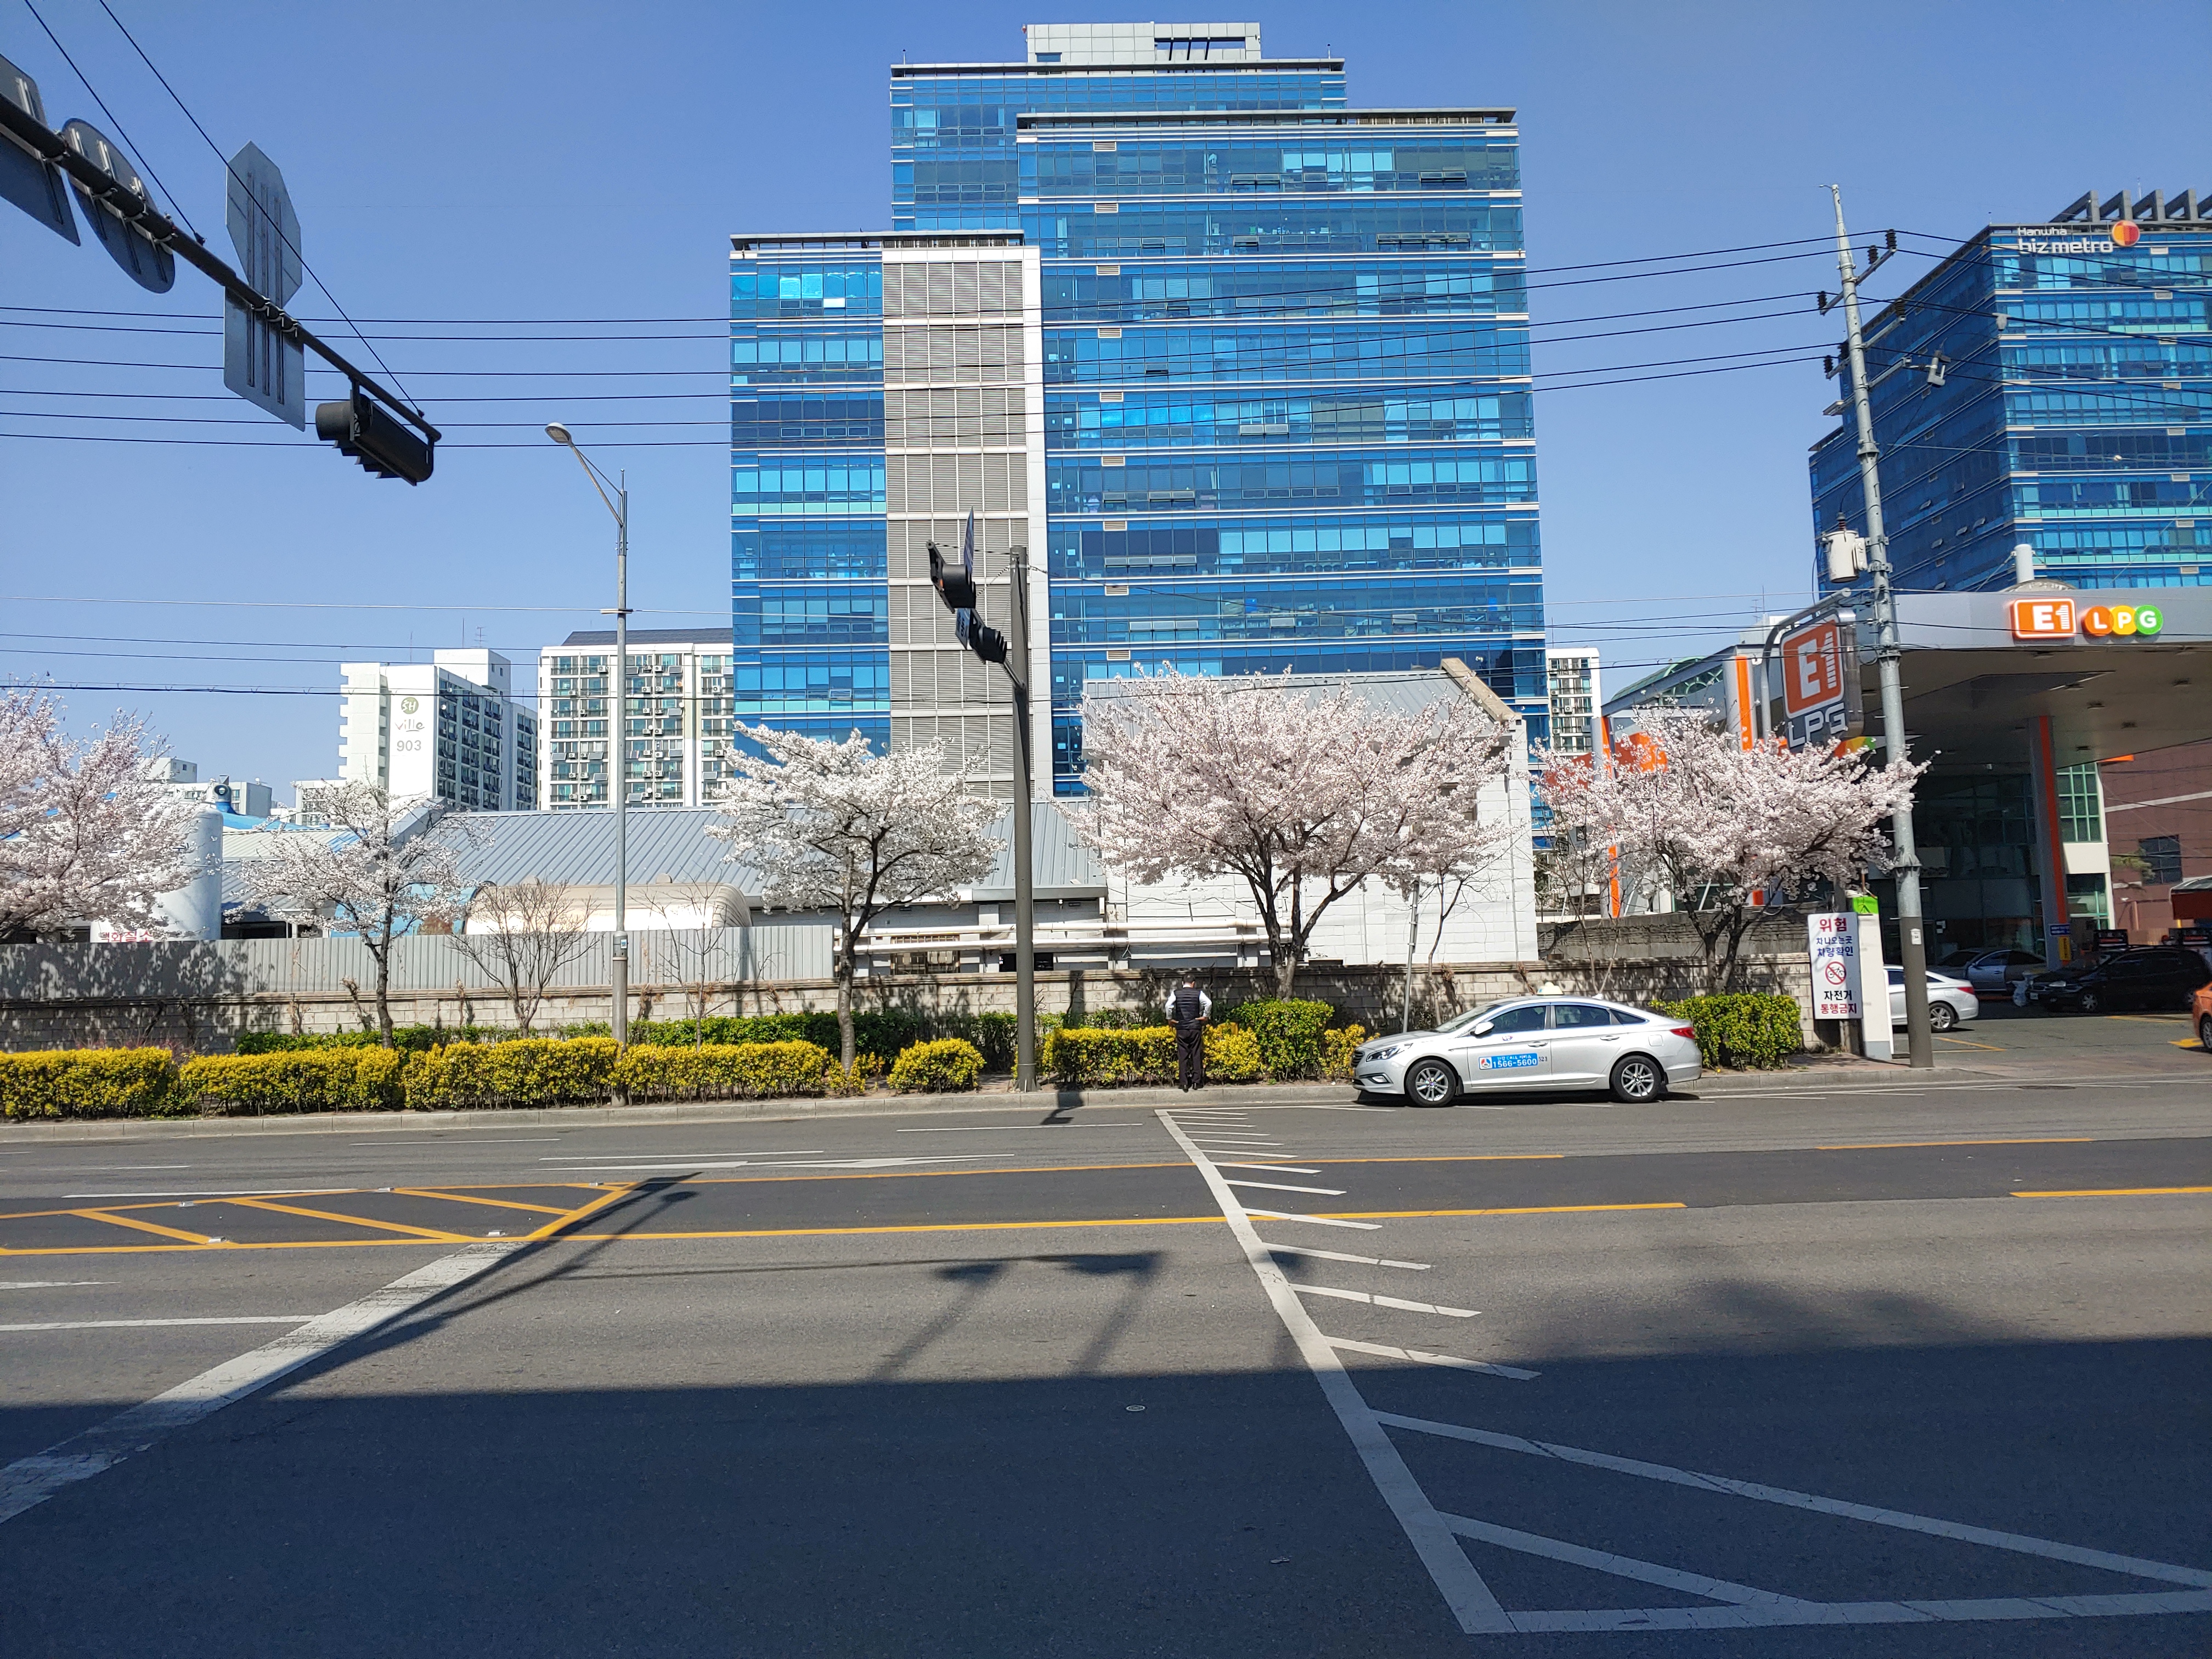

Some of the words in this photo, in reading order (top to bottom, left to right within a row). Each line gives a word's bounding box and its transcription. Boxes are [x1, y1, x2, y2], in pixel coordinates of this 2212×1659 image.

[2018, 227, 2067, 236] Hanwha
[2052, 237, 2113, 253] metro
[2033, 605, 2070, 630] E1
[2094, 611, 2156, 629] LPG
[1798, 631, 1837, 699] E1
[394, 719, 425, 730] ville
[1788, 702, 1846, 748] LPG
[397, 740, 421, 752] 903
[1819, 917, 1847, 932] 위험
[1817, 946, 1854, 957] 차량확인
[1824, 990, 1853, 1001] 자전거
[1820, 1003, 1857, 1014] 통행금지
[1493, 1058, 1537, 1068] 1566-5600
